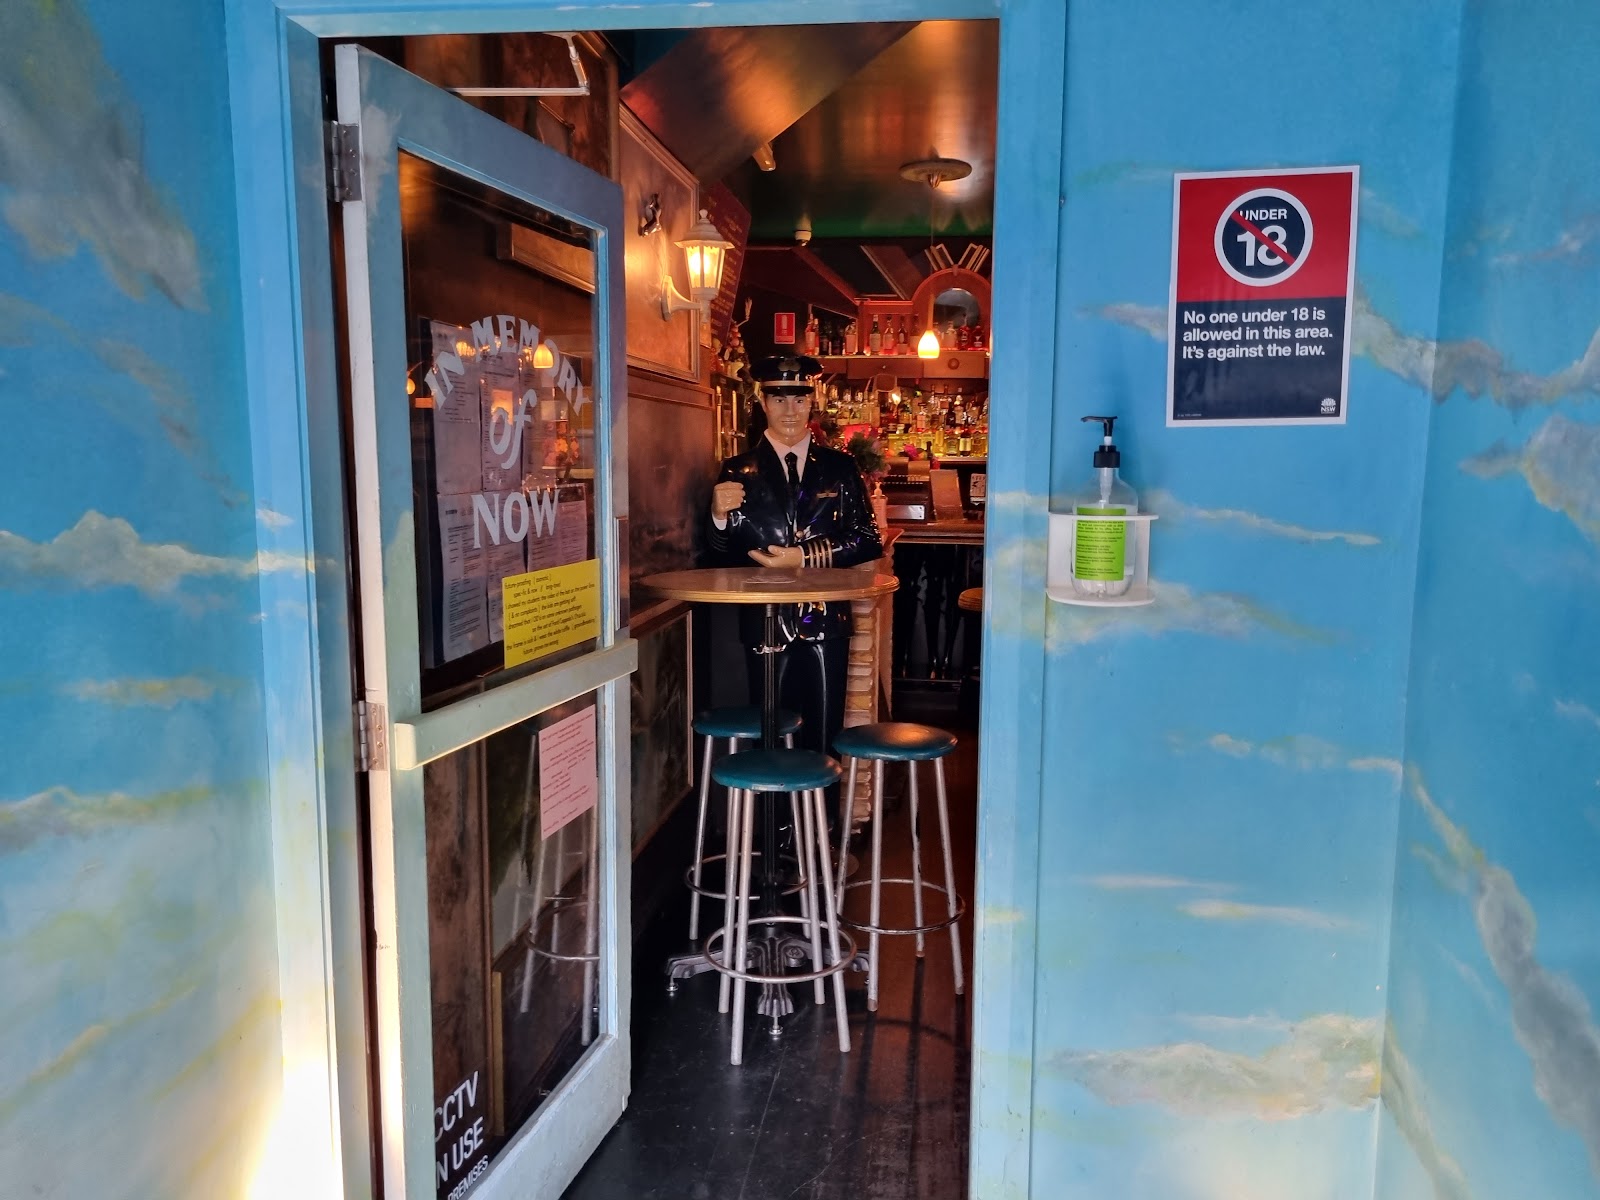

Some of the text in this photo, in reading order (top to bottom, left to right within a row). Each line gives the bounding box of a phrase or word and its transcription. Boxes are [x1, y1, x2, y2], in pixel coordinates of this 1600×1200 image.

[1239, 208, 1288, 221] UNDER
[1236, 225, 1288, 267] 18
[1182, 326, 1333, 342] allowed in this area.
[1184, 307, 1326, 325] No one under 18 is
[424, 314, 593, 416] IN MEMORY
[1182, 343, 1325, 361] It's against the law.
[489, 388, 538, 470] of
[471, 488, 561, 549] NOW
[434, 1070, 479, 1143] CCTV
[436, 1116, 484, 1190] N USE
[447, 1155, 489, 1200] PREMISES
